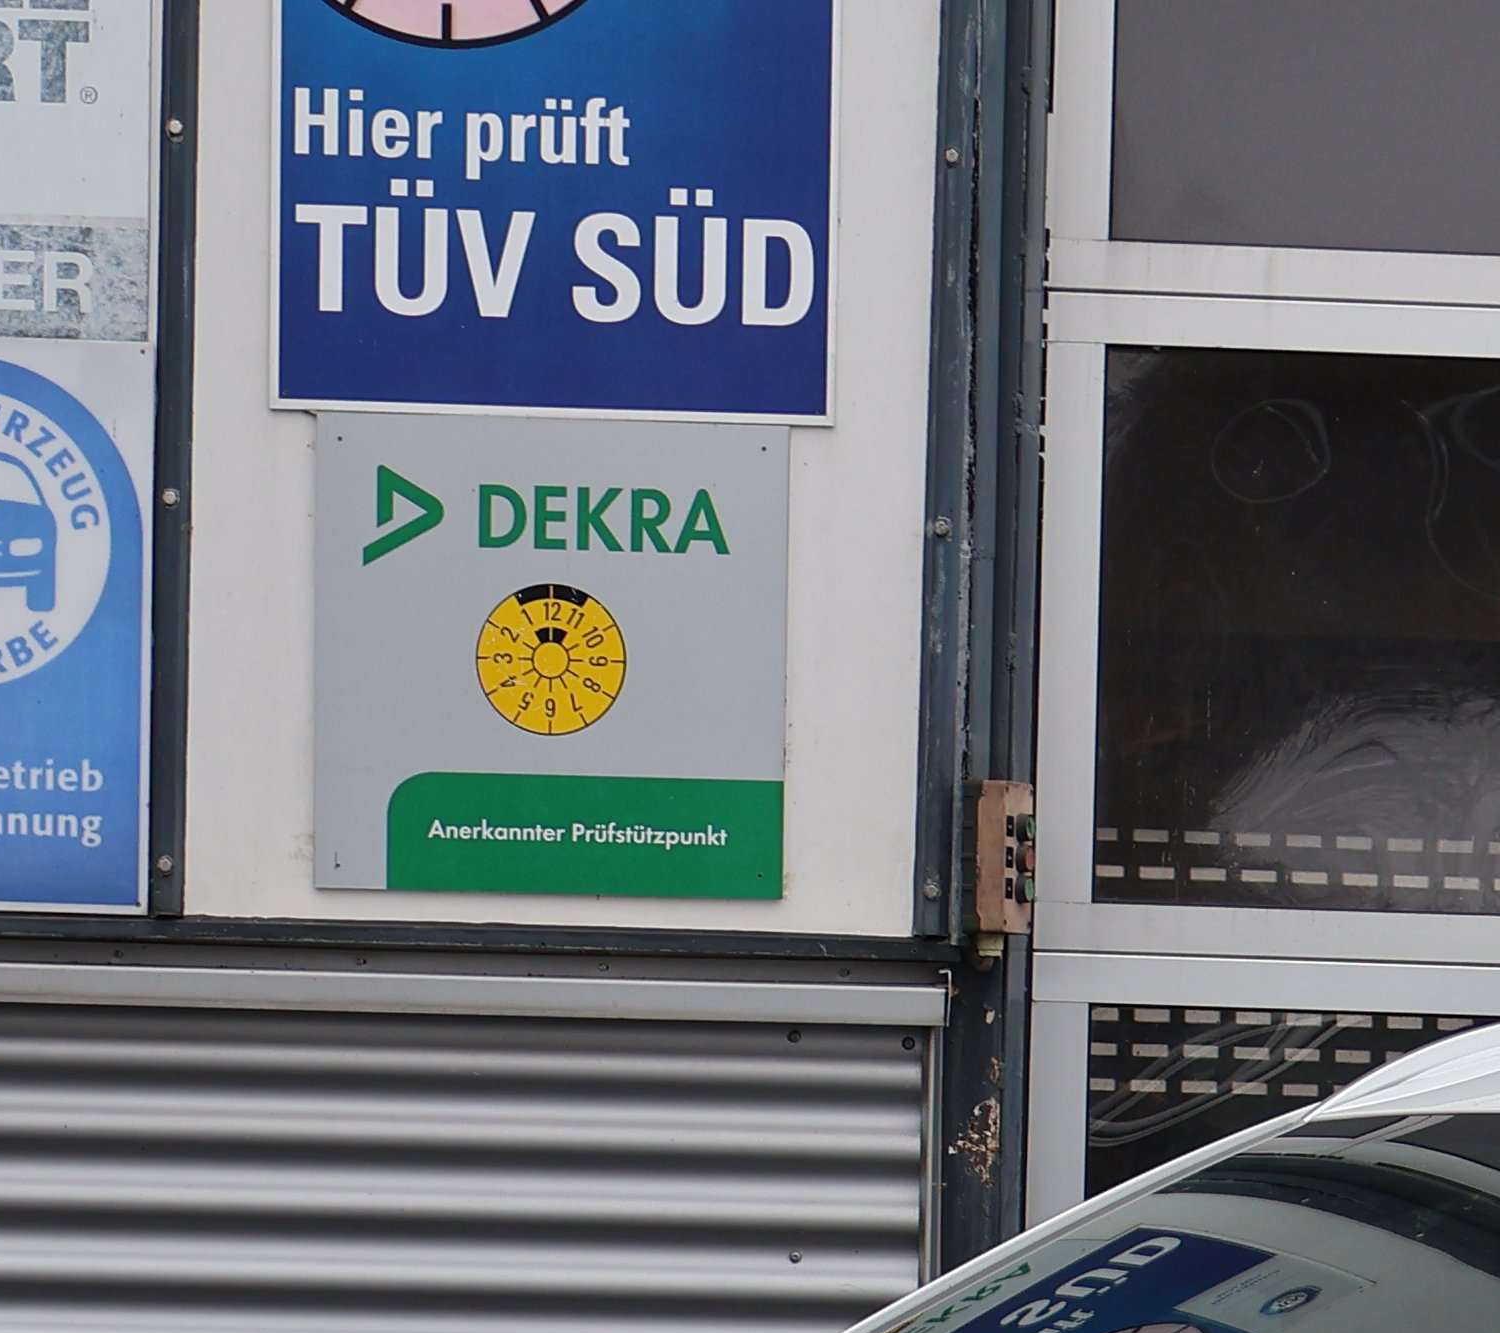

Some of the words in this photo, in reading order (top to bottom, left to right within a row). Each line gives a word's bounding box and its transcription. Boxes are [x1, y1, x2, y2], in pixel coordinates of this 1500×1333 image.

[294, 87, 443, 159] Hier
[466, 97, 630, 180] prüft
[295, 178, 535, 318] TÜV
[572, 188, 815, 326] SÜD
[478, 484, 729, 555] DEKRA
[542, 601, 562, 621] 12
[428, 819, 565, 843] Anerkannter
[571, 822, 728, 851] Prüfstützpunkt
